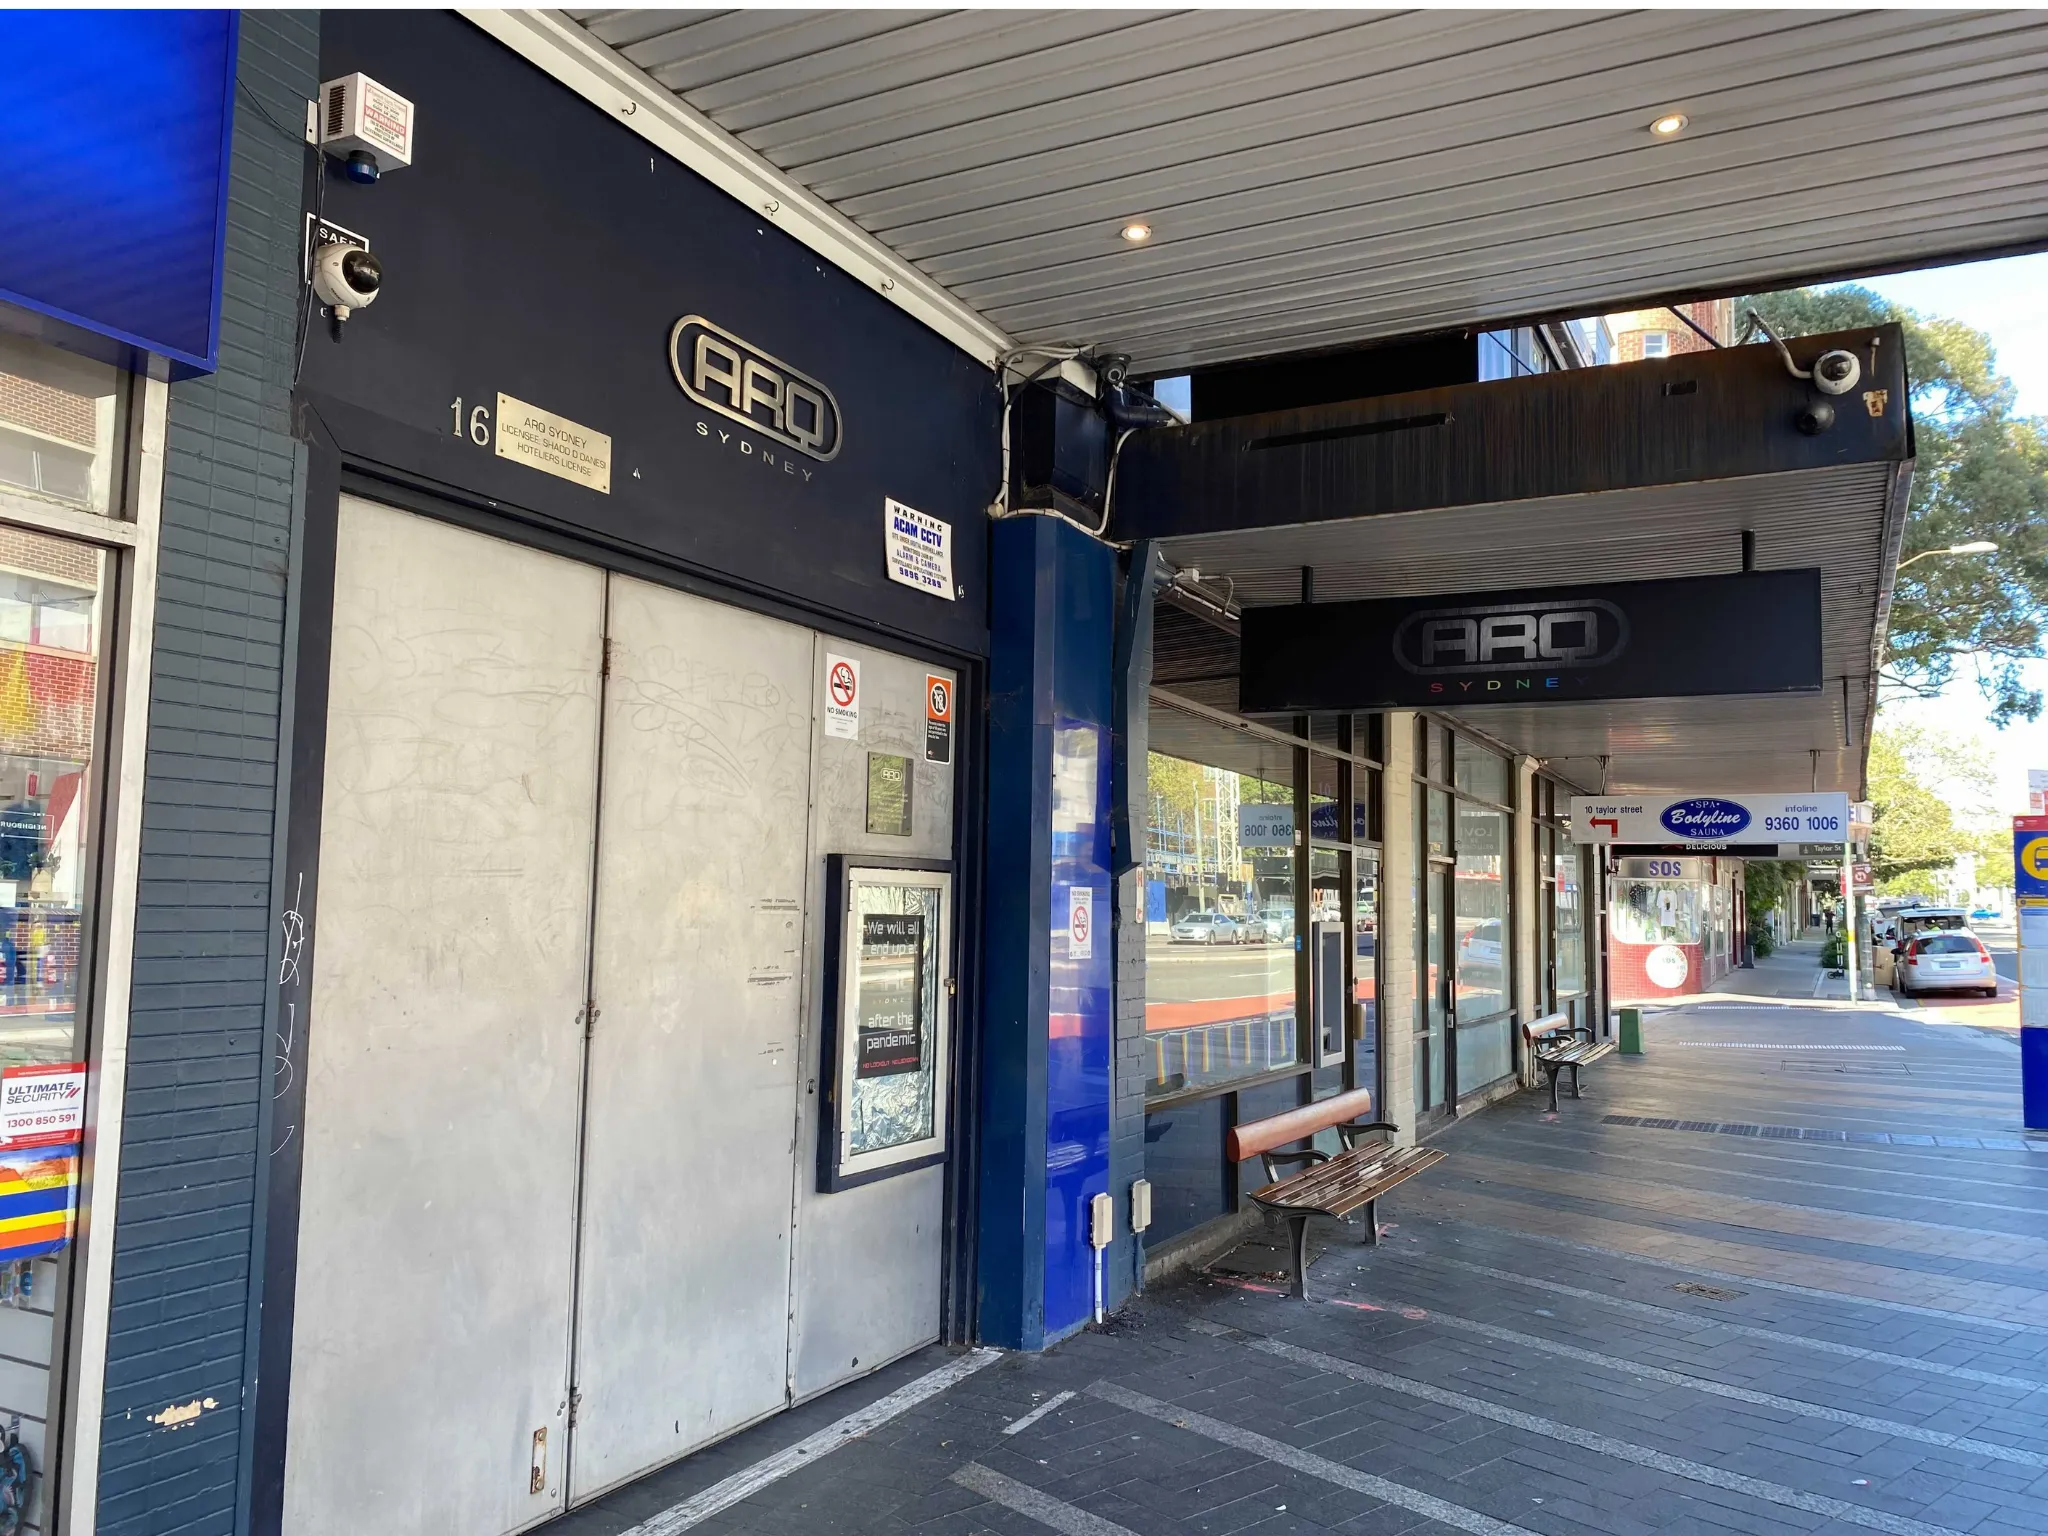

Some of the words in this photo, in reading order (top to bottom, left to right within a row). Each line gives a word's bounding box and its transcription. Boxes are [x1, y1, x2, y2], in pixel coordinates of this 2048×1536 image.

[695, 334, 824, 451] ARQ
[450, 396, 490, 446] 16
[524, 417, 546, 434] ARQ
[548, 426, 588, 449] SYDNEY
[517, 442, 560, 465] HOTELIERS
[561, 458, 592, 476] LICENSE
[572, 450, 578, 459] D
[695, 421, 813, 482] SYDNEY
[893, 504, 943, 531] WARNING
[893, 516, 918, 538] ACAM
[920, 527, 942, 547] CCTV
[896, 548, 914, 563] ALARM
[920, 558, 942, 573] CAMERA
[1422, 611, 1598, 667] ARQ
[1430, 675, 1590, 693] SYDNEY
[827, 706, 835, 714] NO
[835, 708, 858, 719] SMOKING
[1585, 806, 1593, 814] 10
[1596, 805, 1617, 816] taylor
[1620, 806, 1643, 814] street
[1785, 804, 1818, 813] infoline
[1670, 809, 1741, 828] Bodyline
[1765, 816, 1800, 831] 9360
[1806, 816, 1839, 831] 1006
[1690, 828, 1725, 836] SAUNA
[1813, 845, 1833, 853] Taylor
[1649, 860, 1682, 877] SOS
[867, 921, 884, 935] We
[887, 920, 905, 935] will
[907, 921, 920, 935] all
[870, 941, 889, 955] end
[892, 944, 906, 957] up
[906, 942, 919, 954] at
[868, 1013, 895, 1029] after
[897, 1012, 914, 1026] the
[866, 1033, 916, 1054] pandemic
[8, 1081, 75, 1096] ULTIMATE
[6, 1091, 67, 1105] SECURITY
[7, 1118, 33, 1128] 1300
[35, 1115, 56, 1126] 850
[58, 1113, 76, 1123] 591
